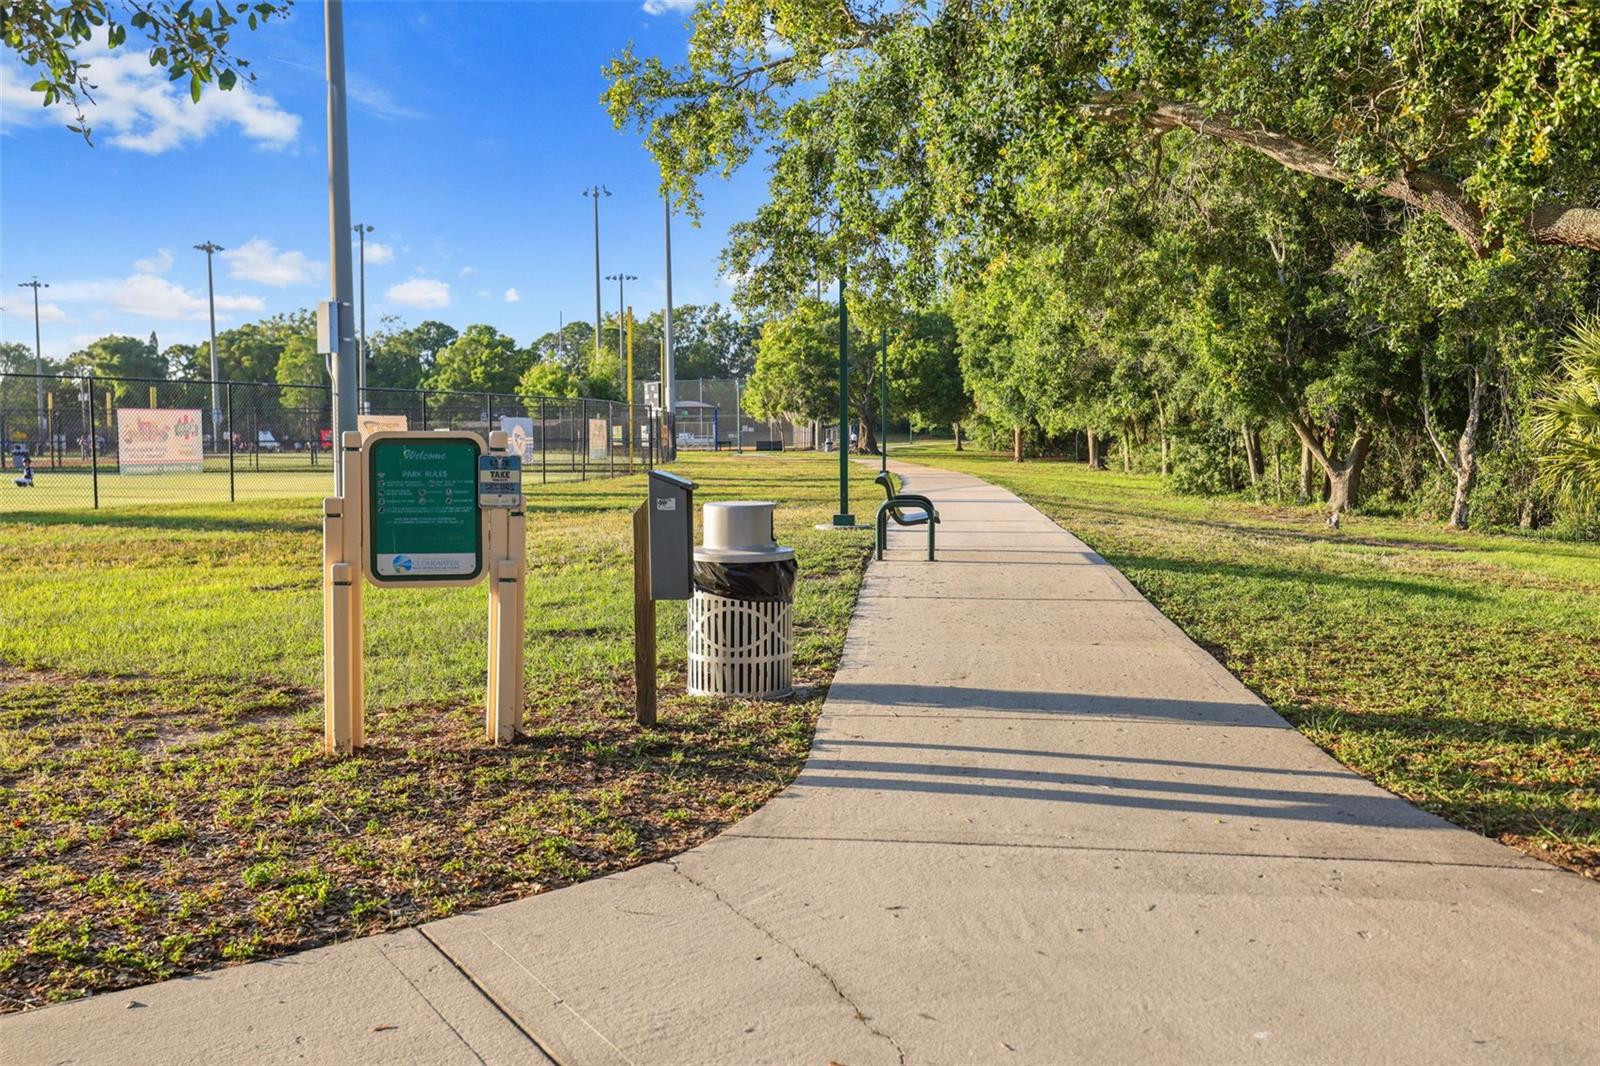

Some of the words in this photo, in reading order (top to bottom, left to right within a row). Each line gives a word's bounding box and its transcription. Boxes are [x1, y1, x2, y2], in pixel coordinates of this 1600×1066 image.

[403, 448, 447, 460] Welcome
[402, 470, 422, 478] PARK
[424, 470, 448, 478] RULES
[490, 471, 511, 479] TAKE
[412, 559, 460, 567] CLEARWATER
